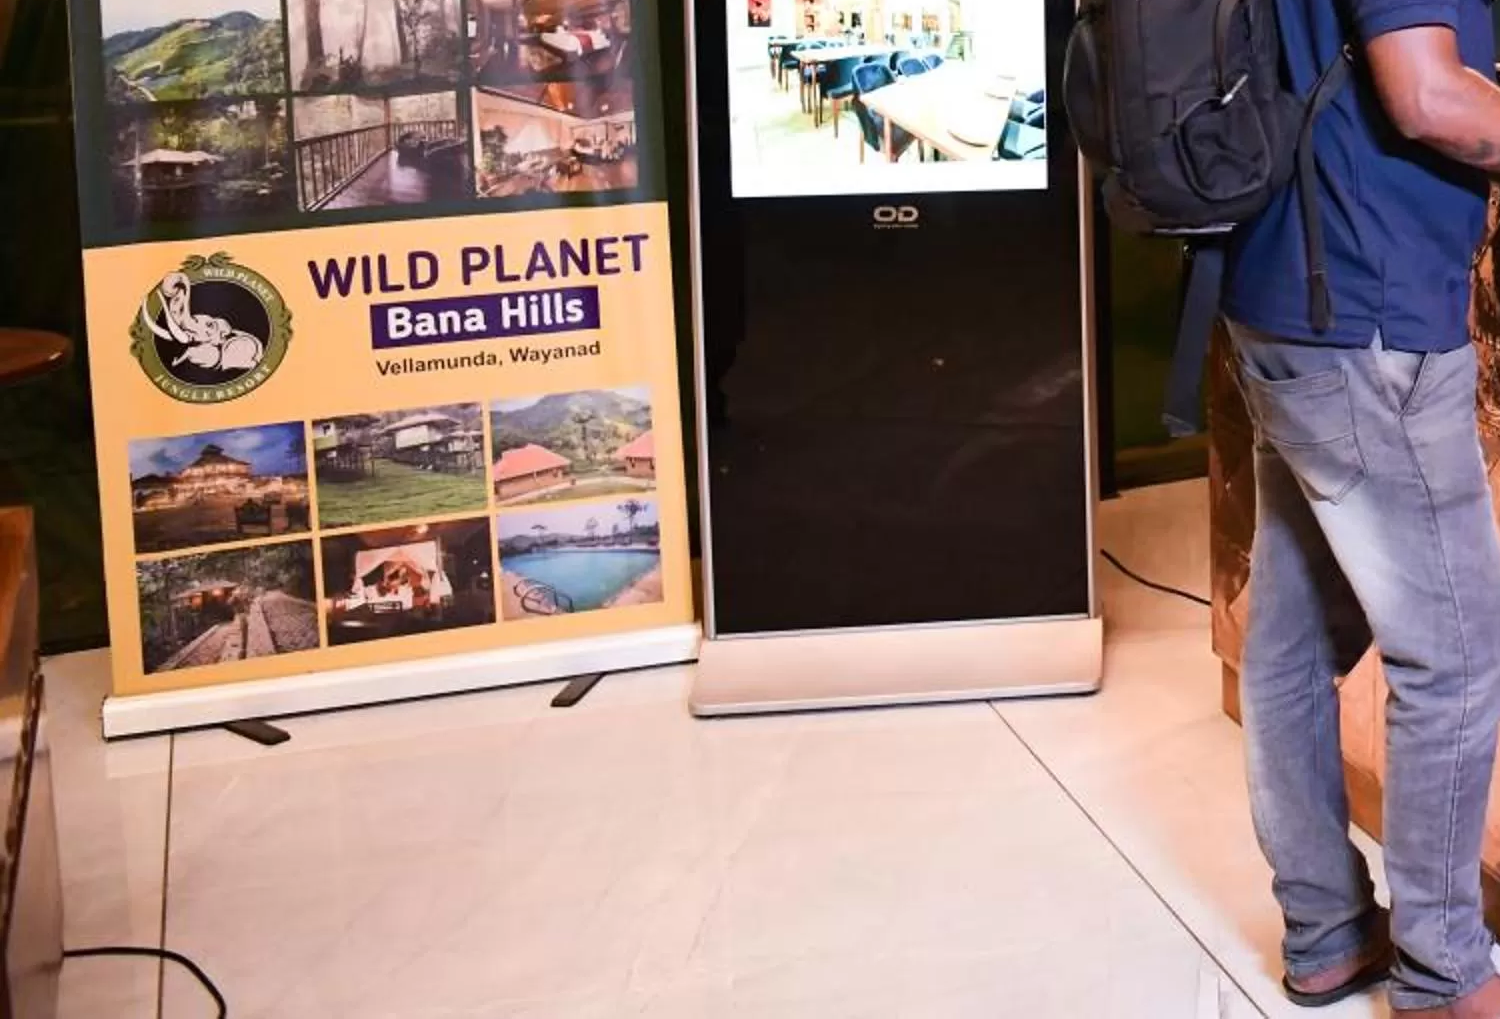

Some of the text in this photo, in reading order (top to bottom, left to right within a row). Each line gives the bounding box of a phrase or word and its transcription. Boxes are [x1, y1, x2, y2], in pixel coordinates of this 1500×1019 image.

[308, 234, 649, 298] WILD PLANET
[387, 292, 585, 341] Bana Hills
[376, 340, 601, 377] Vellamunda, Wayanad
